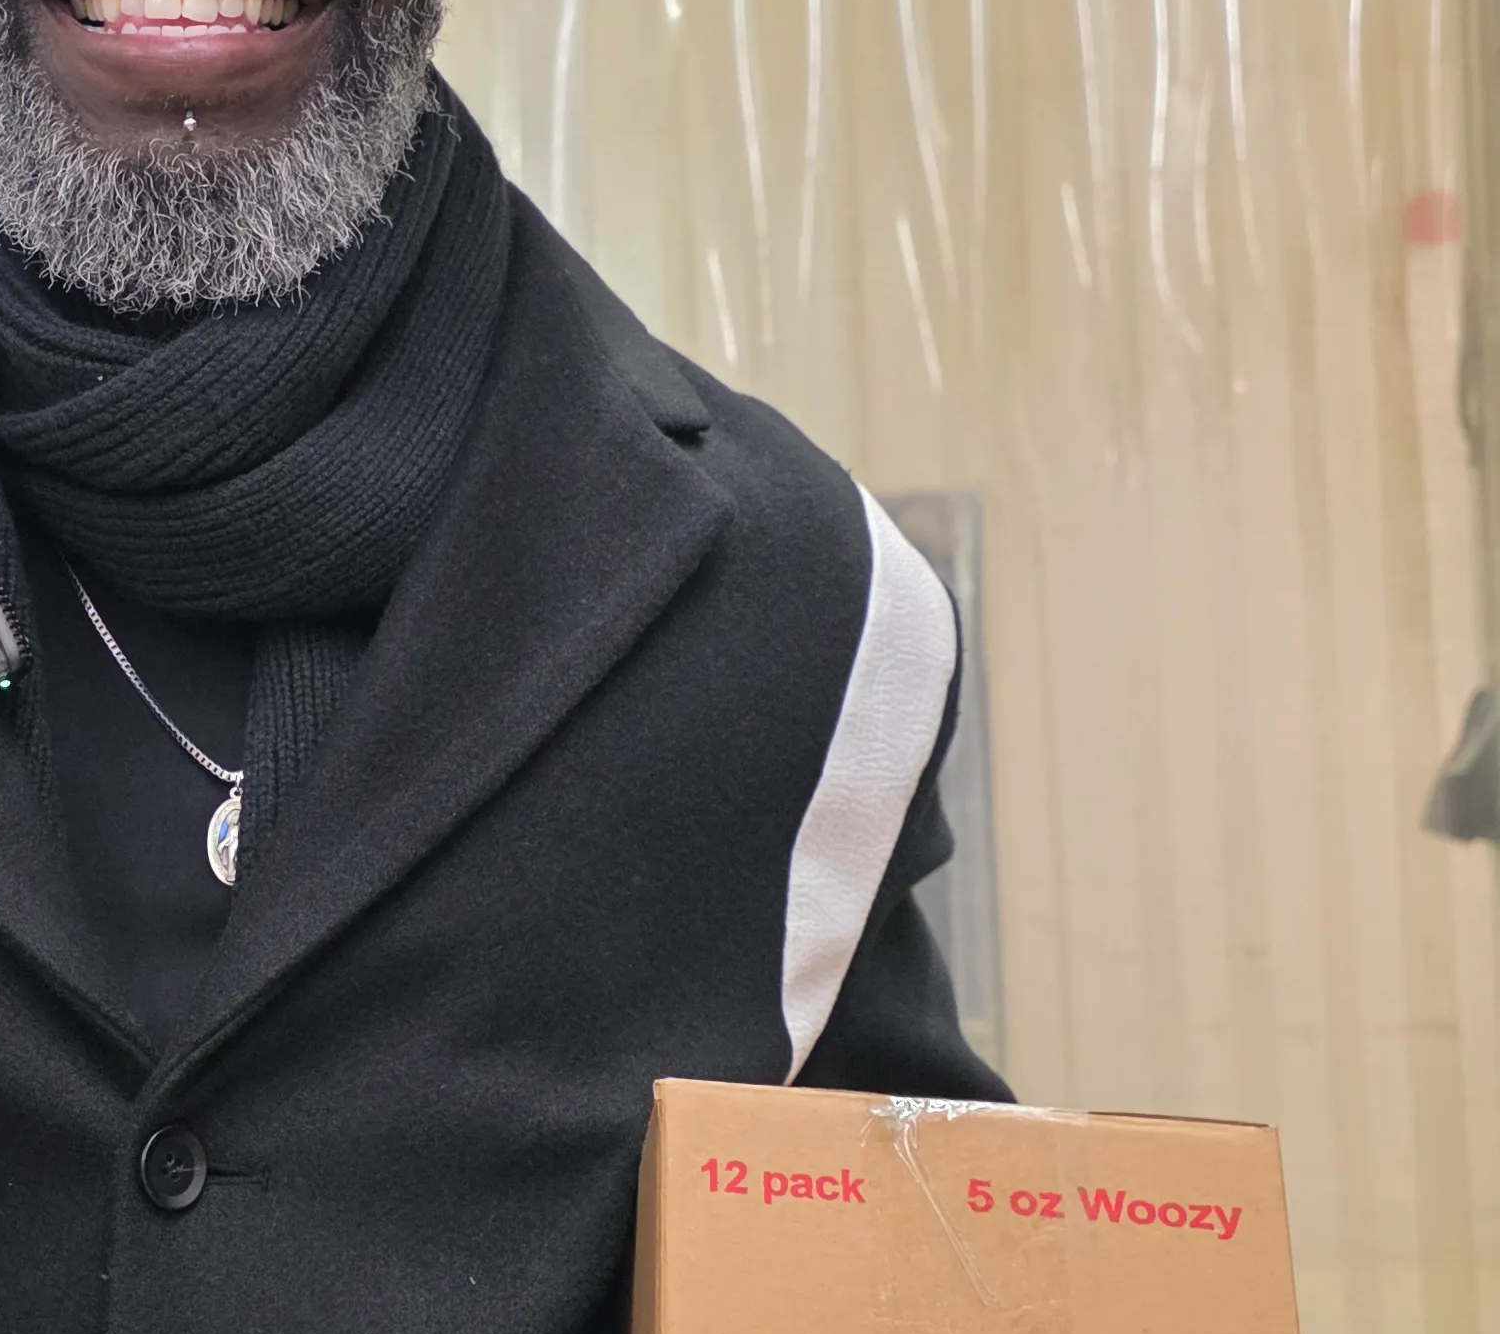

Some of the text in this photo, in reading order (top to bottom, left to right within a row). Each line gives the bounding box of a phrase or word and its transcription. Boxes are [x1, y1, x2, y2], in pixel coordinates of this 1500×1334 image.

[701, 1159, 1243, 1240] 12 pack 5 oz Woozy
